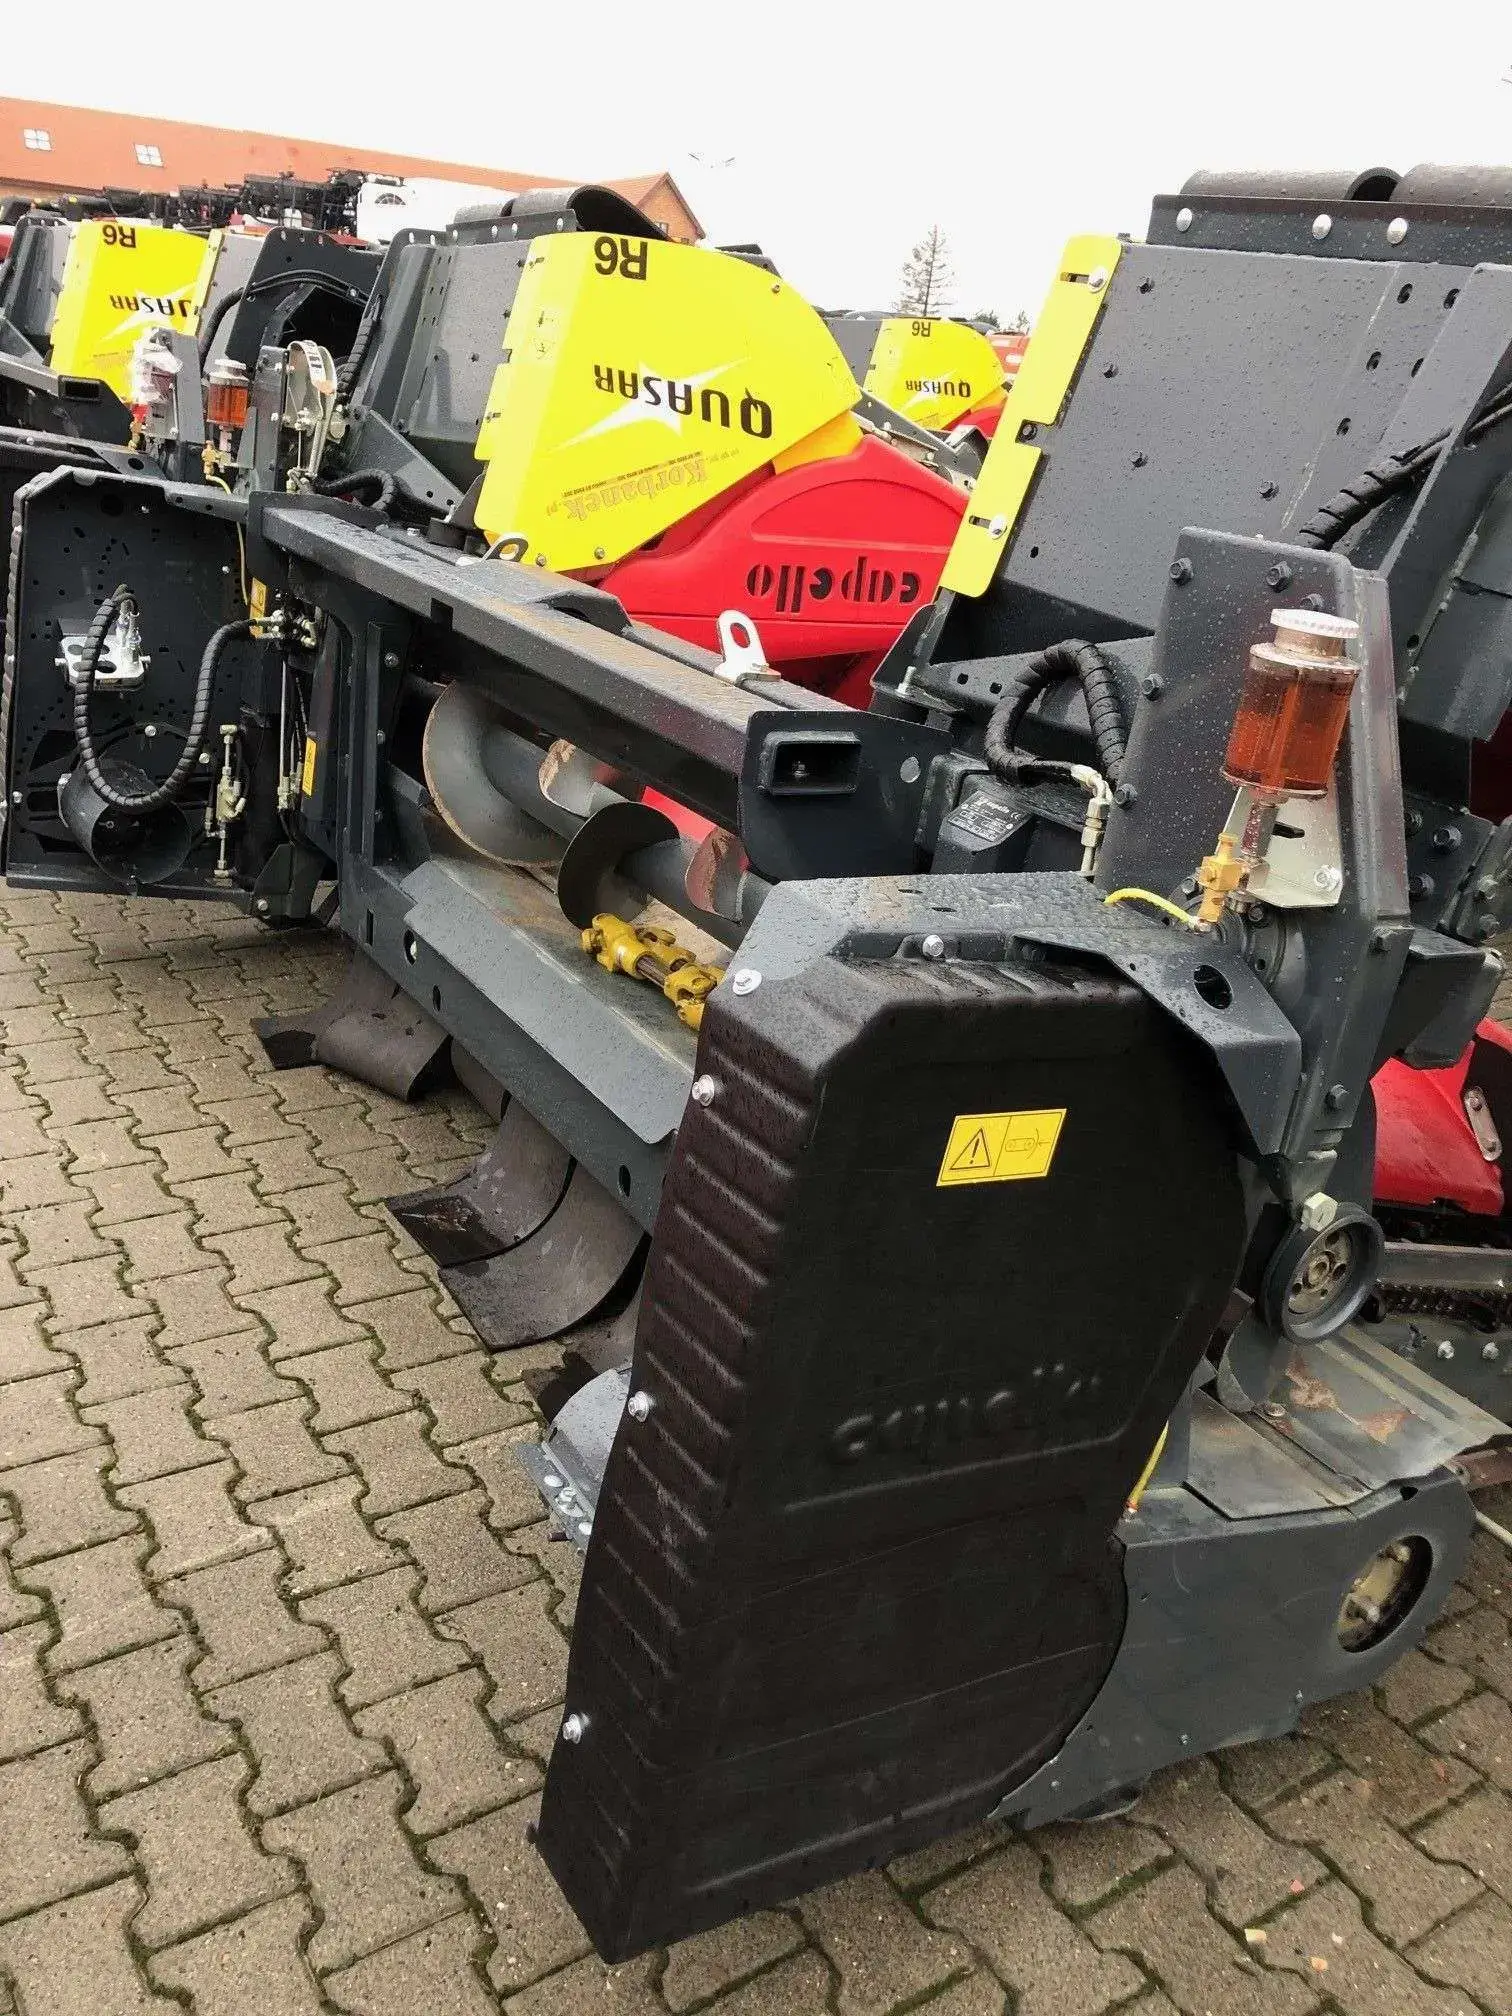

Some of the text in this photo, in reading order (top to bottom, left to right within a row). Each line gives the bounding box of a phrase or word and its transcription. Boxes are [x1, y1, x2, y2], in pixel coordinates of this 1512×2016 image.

[102, 224, 136, 248] R6
[593, 236, 649, 281] R6
[110, 295, 191, 317] UASAR
[911, 320, 931, 338] R6
[905, 379, 972, 398] QUASAR
[593, 364, 773, 440] QUASAR
[747, 557, 920, 613] capello
